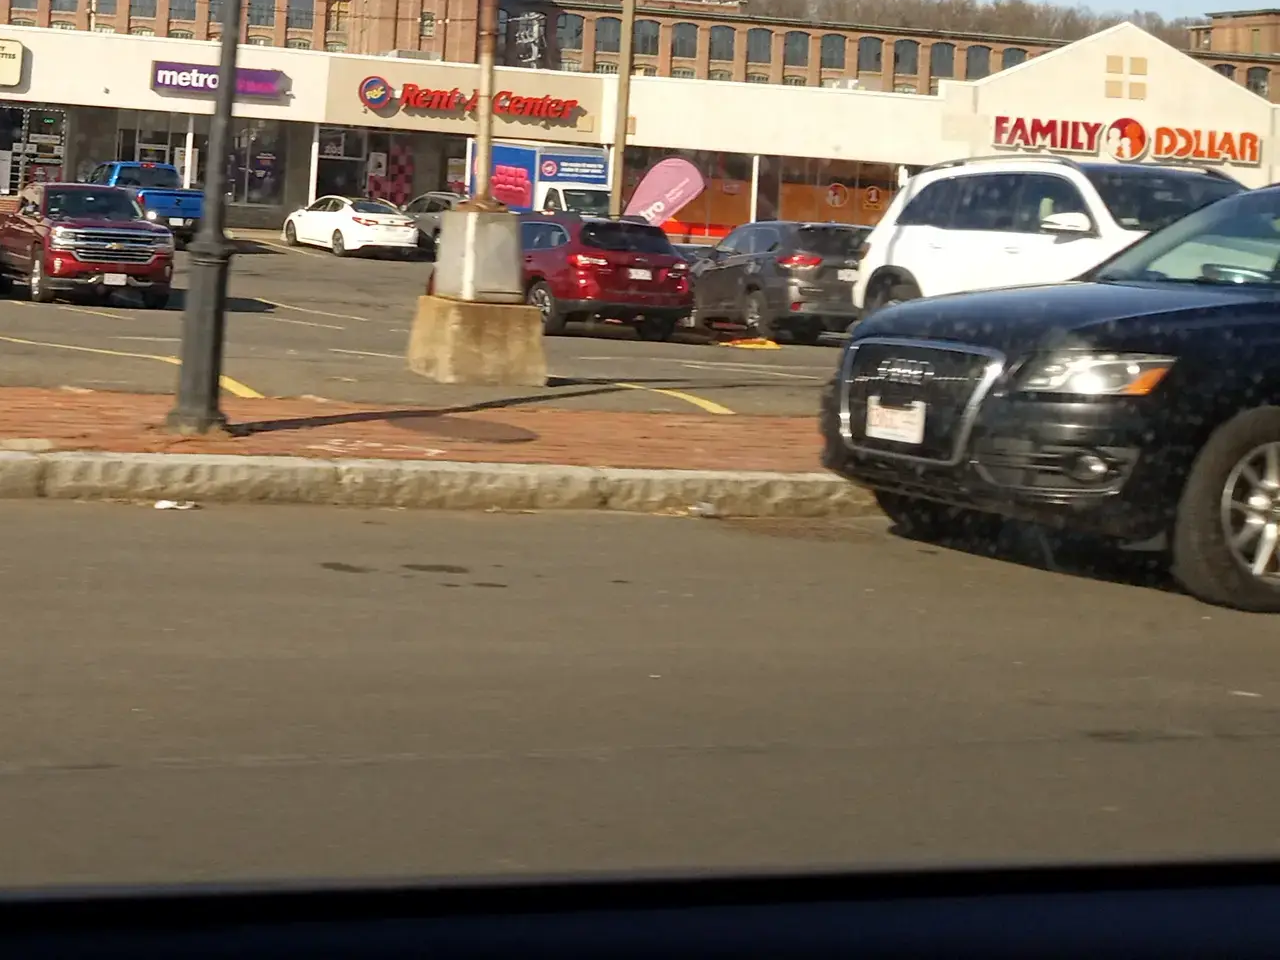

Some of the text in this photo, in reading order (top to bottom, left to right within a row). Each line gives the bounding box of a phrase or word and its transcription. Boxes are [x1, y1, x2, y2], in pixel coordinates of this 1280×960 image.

[157, 69, 219, 89] metro
[994, 116, 1259, 161] FAMILY DOLLAR
